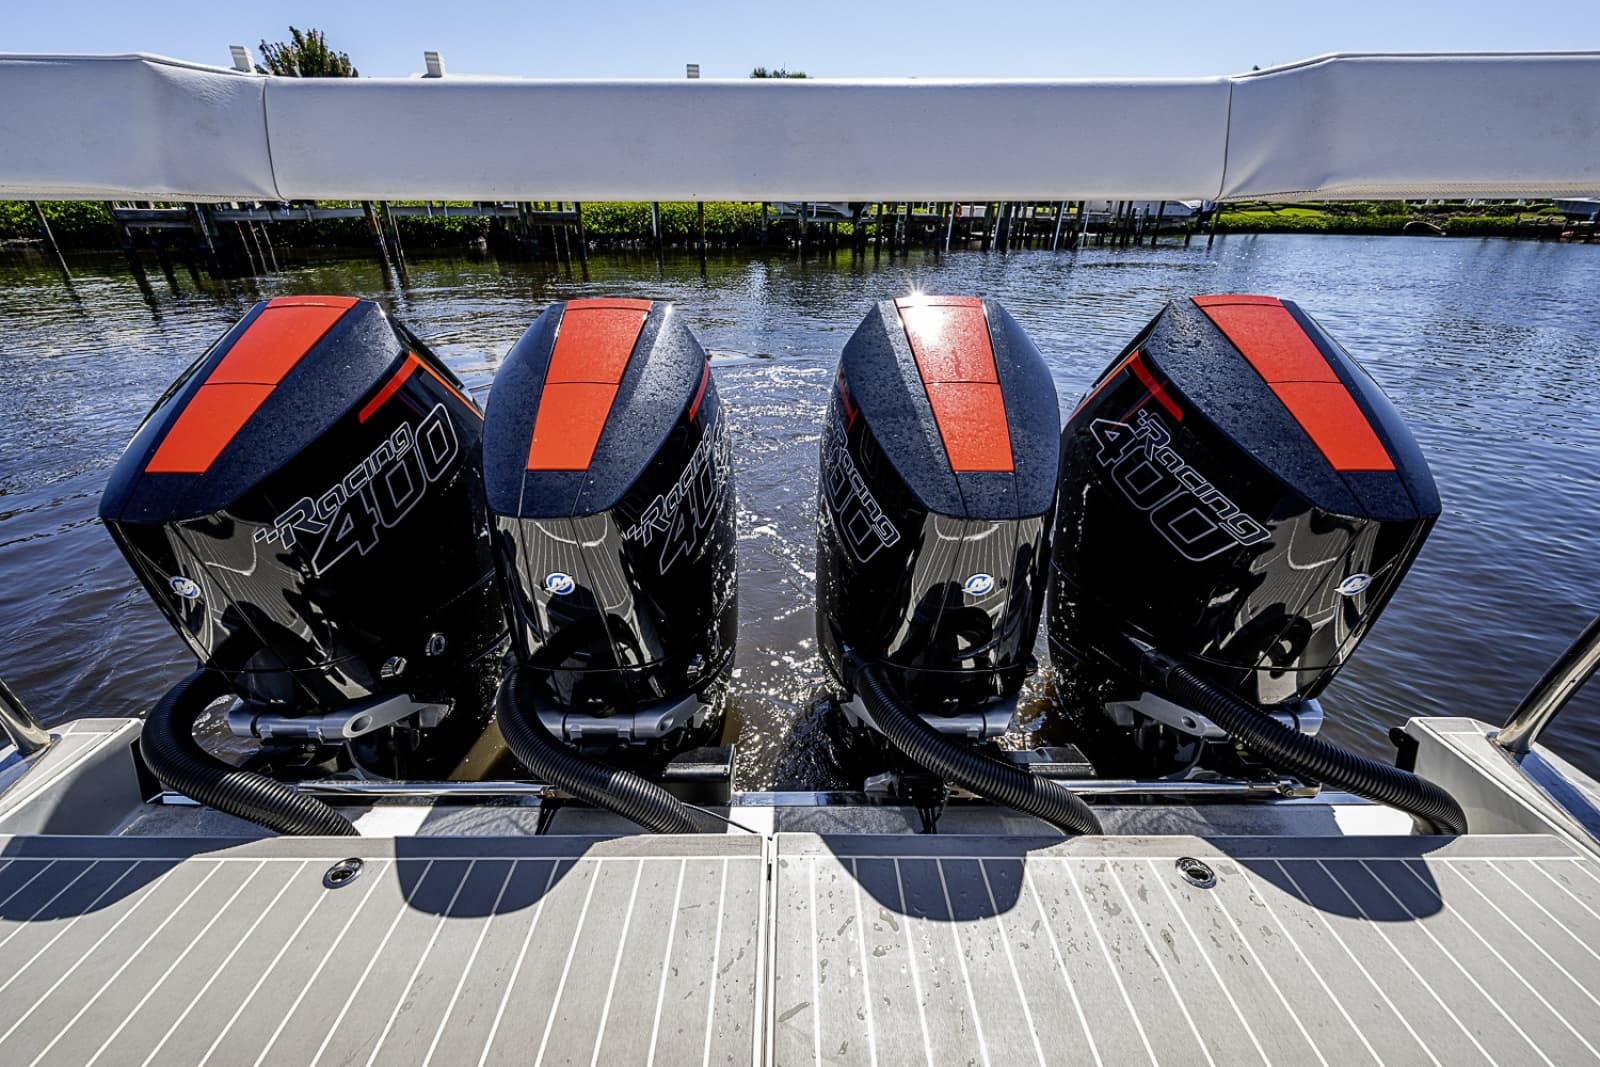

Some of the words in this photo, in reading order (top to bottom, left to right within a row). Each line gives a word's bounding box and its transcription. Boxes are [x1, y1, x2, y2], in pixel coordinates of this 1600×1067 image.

[274, 421, 414, 549] Racing
[312, 403, 458, 575] 400
[1090, 418, 1238, 562] 400
[1135, 418, 1271, 546] Racing
